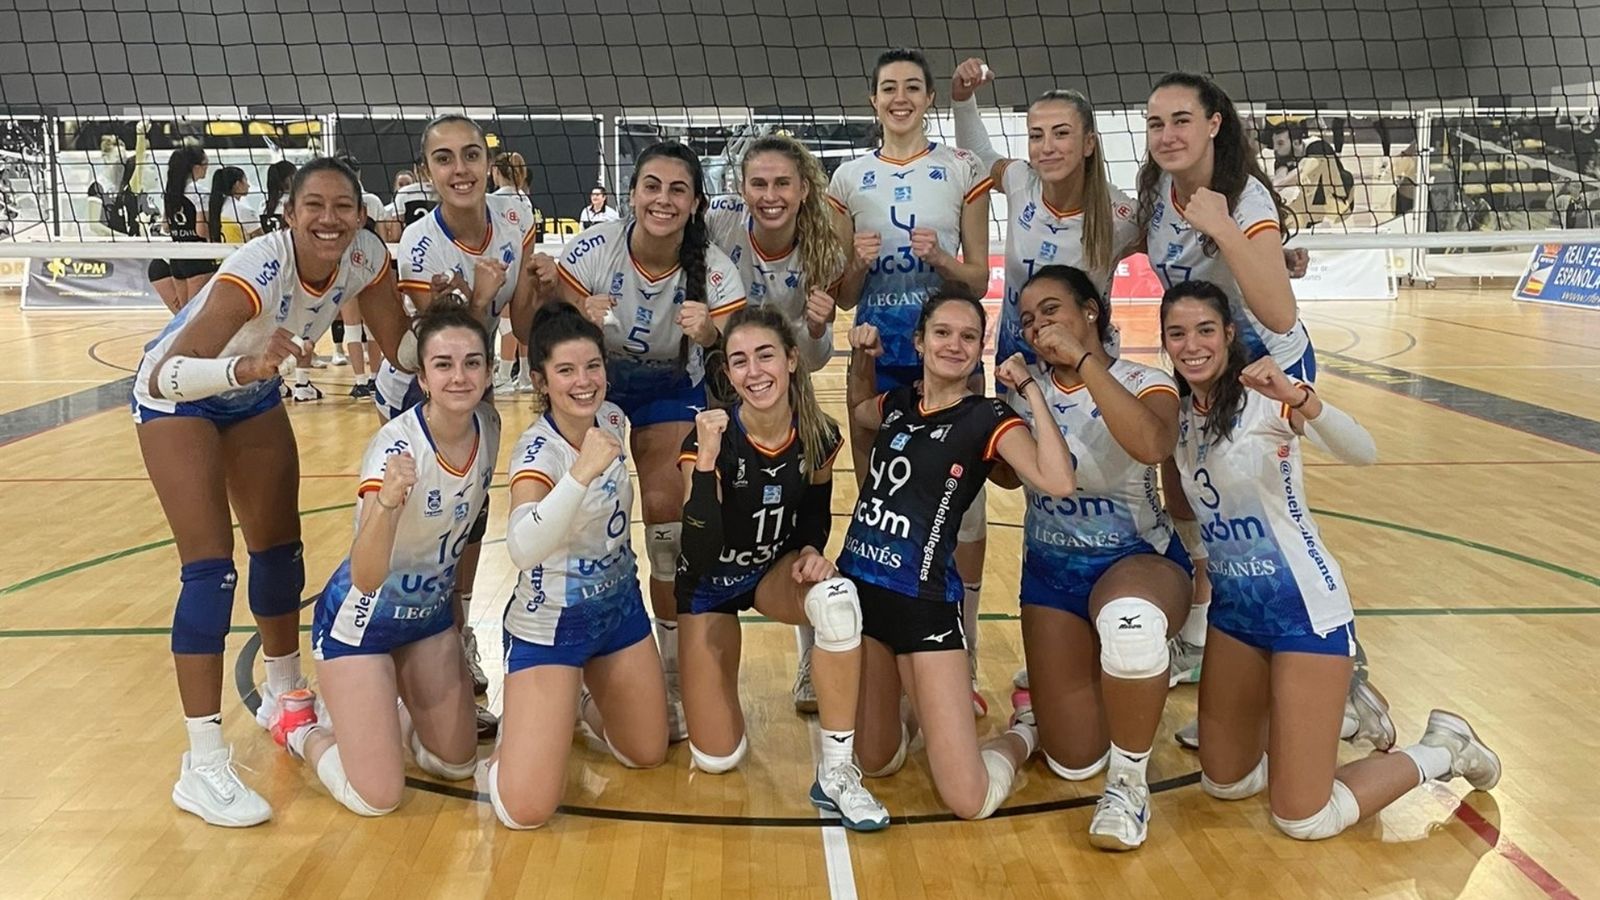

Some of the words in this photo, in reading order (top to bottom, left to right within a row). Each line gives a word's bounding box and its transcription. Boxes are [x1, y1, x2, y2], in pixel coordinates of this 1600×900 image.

[72, 262, 107, 274] VPM
[412, 235, 432, 273] uc3m
[566, 234, 606, 265] uc3m
[622, 326, 650, 354] 5
[870, 447, 911, 496] 49
[1194, 468, 1221, 509] 3
[606, 499, 627, 539] 6
[752, 506, 785, 543] 11
[855, 497, 911, 539] c3m
